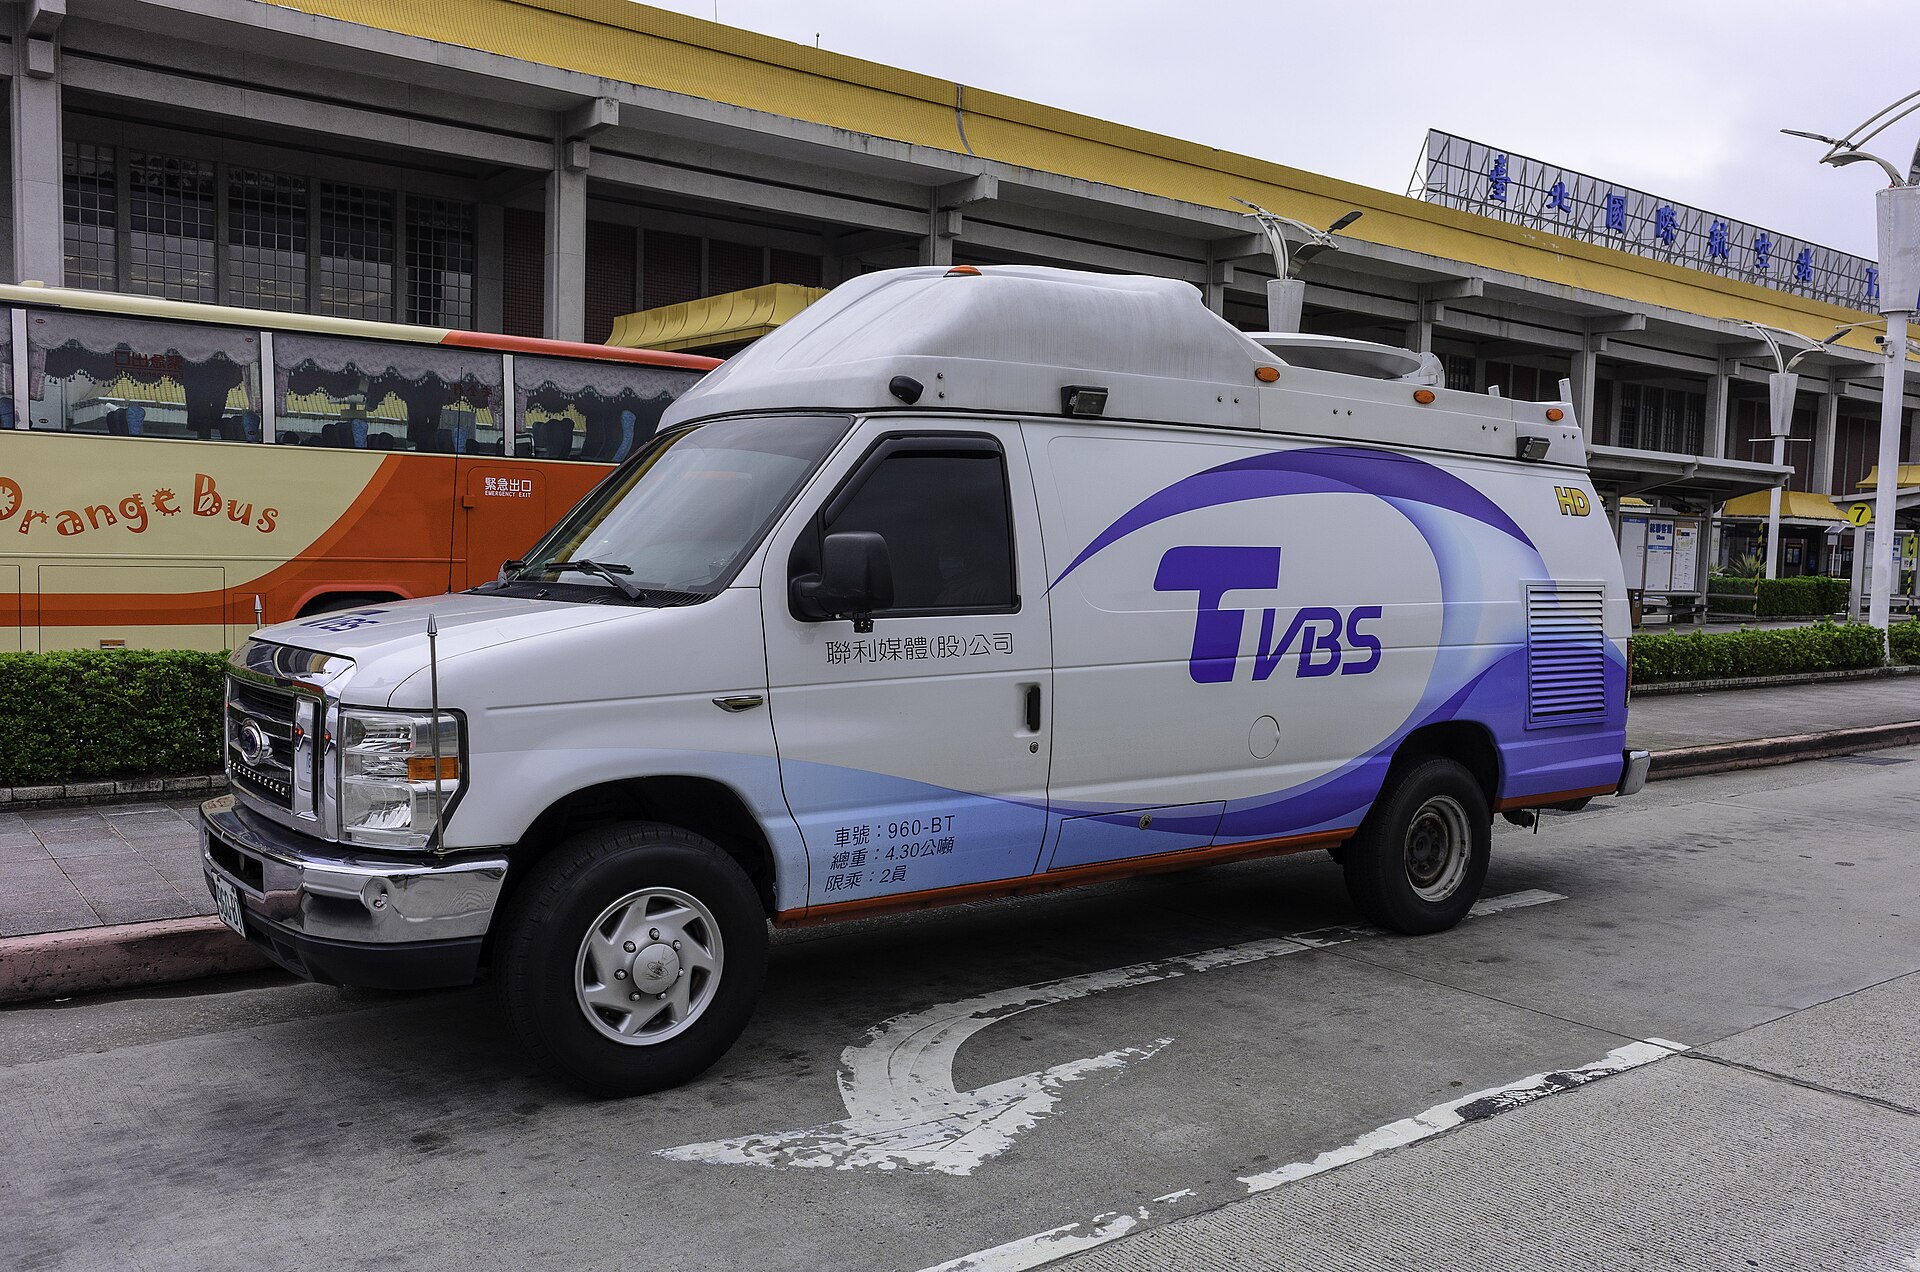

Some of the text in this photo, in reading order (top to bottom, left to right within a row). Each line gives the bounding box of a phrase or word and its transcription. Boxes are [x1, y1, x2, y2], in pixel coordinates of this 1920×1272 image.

[484, 477, 531, 491] 緊急出口
[192, 473, 279, 534] Bus
[1553, 485, 1591, 517] HD
[1854, 506, 1866, 522] 7
[1154, 546, 1383, 684] TVBS
[826, 632, 1014, 664] 聯利媒體(股)公司
